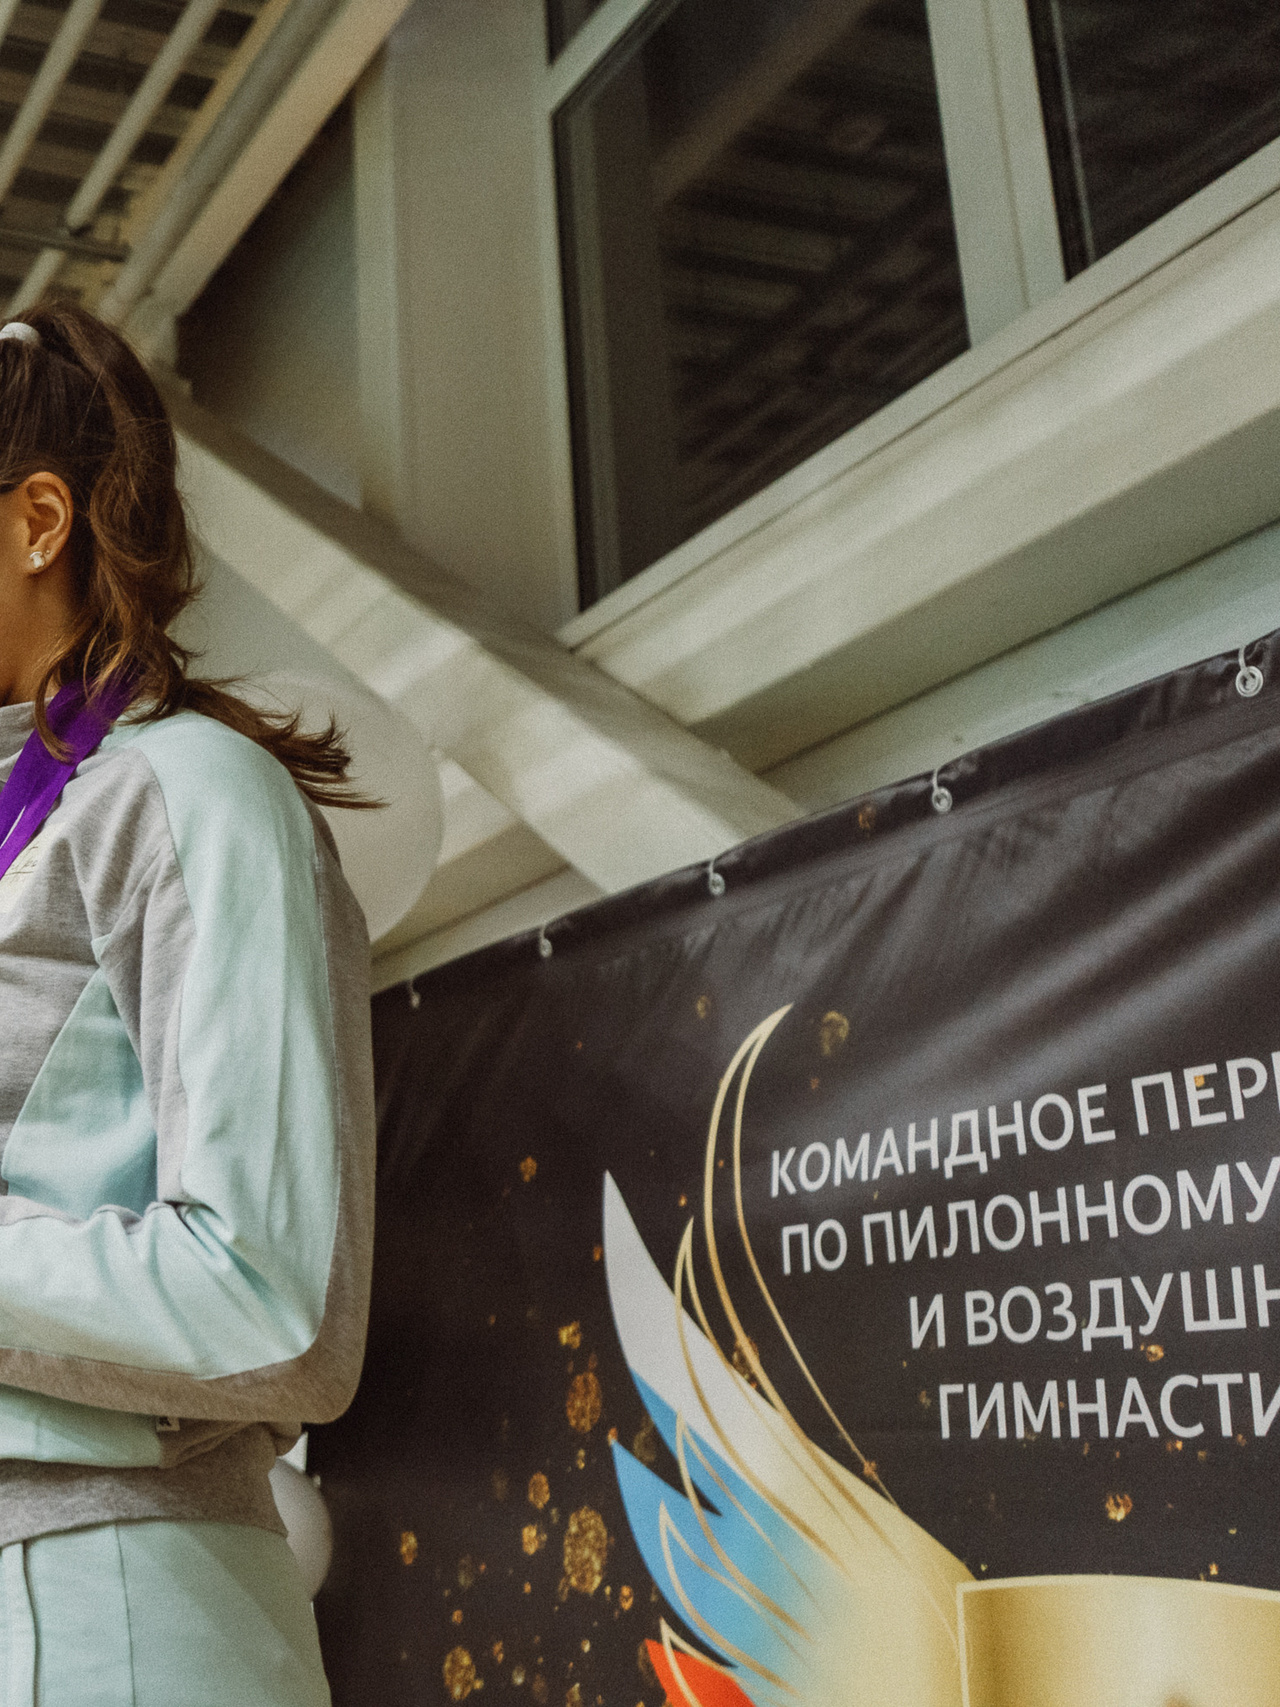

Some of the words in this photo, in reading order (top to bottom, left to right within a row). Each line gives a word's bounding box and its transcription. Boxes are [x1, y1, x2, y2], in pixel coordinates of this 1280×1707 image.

[771, 1083, 1116, 1198] КОМАНДНОЕ
[1131, 1051, 1280, 1135] ПЕР
[782, 1218, 847, 1275] ПО
[862, 1156, 1280, 1265] ПИЛОННОМУ
[909, 1293, 946, 1349] И
[965, 1264, 1280, 1352] ВОЗДУШН
[939, 1371, 1280, 1439] ГИМНАСТИ
